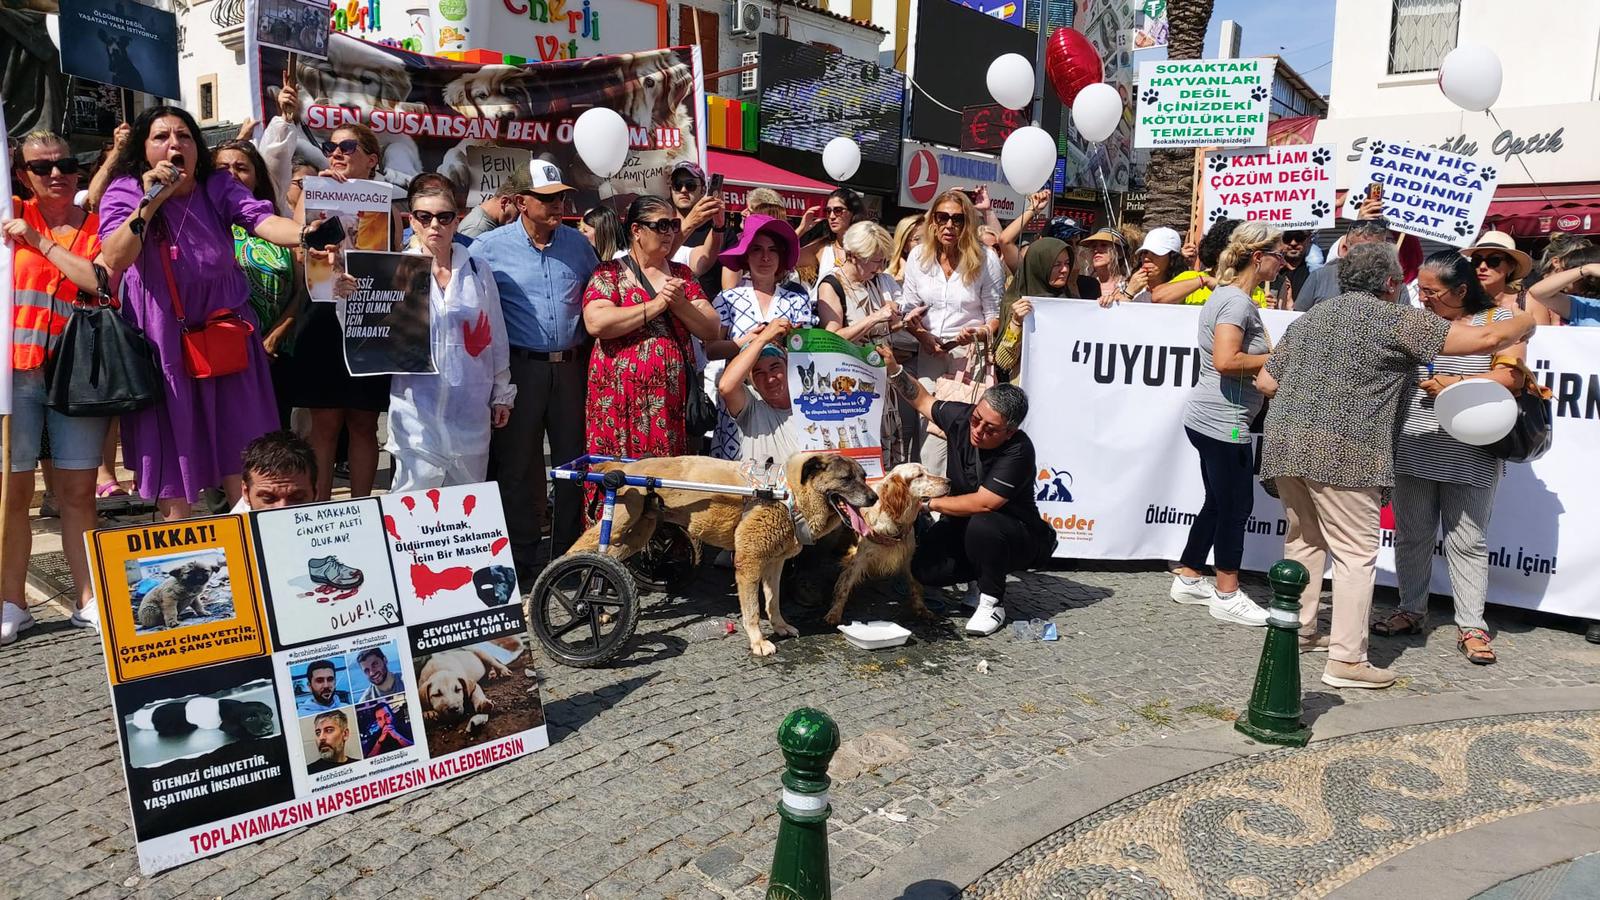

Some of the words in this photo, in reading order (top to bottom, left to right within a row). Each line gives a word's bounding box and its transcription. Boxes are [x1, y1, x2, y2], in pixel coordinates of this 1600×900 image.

[93, 9, 125, 24] ÖLDÜREN
[1156, 61, 1258, 73] SOKAKTAKİ
[1151, 75, 1260, 86] HAYVANLARI
[1180, 88, 1231, 98] DEĞİL
[1157, 100, 1252, 113] İÇİNİZDEKİ
[308, 104, 361, 129] SEN
[370, 109, 500, 140] SUSARSAN
[507, 120, 550, 142] BEN
[1142, 112, 1264, 125] KÖTÜLÜKLERİ
[1151, 126, 1255, 138] TEMİZLEYİN
[1492, 127, 1565, 162] Optik
[1232, 150, 1308, 168] KATLİAM
[1387, 144, 1431, 162] SEN
[1437, 155, 1477, 175] HİÇ
[1210, 170, 1273, 190] ÇÖZÜM
[1278, 167, 1329, 183] DEĞİL
[1370, 156, 1483, 191] BARINAĞA
[1371, 172, 1474, 204] GİRDİNMİ
[989, 198, 1015, 210] rendon
[1219, 188, 1316, 207] YAŞATMAYI
[1364, 186, 1470, 219] LDÜRME
[1247, 208, 1292, 221] DENE
[356, 275, 374, 289] SSİZ
[365, 302, 392, 314] OLMAK
[346, 326, 391, 338] BURADAYIZ
[317, 505, 361, 520] AYAKKABI
[126, 524, 217, 552] DİKKAT!
[395, 536, 451, 553] Öldürmeyi
[453, 529, 503, 544] Saklamak
[1145, 504, 1198, 526] Öldürm
[1516, 547, 1557, 577] İçin!
[437, 549, 453, 560] Bir
[456, 543, 492, 557] Maske!
[482, 623, 502, 637] DUR
[505, 620, 520, 630] DE!
[120, 637, 177, 656] ÖTENAZİ
[122, 647, 177, 664] YAŞAMA
[179, 639, 213, 655] ŞANS
[215, 632, 257, 646] VERİN!
[143, 784, 209, 810] YAŞATMAK
[211, 766, 282, 793] İNSANLIKTIR!
[152, 769, 201, 792] ÖTENAZİ
[189, 801, 313, 854] TOPLAYAMAZSIN
[317, 767, 427, 817] HAPSEDEMEZSİN
[429, 738, 525, 784] KATLEDEMEZSİN
